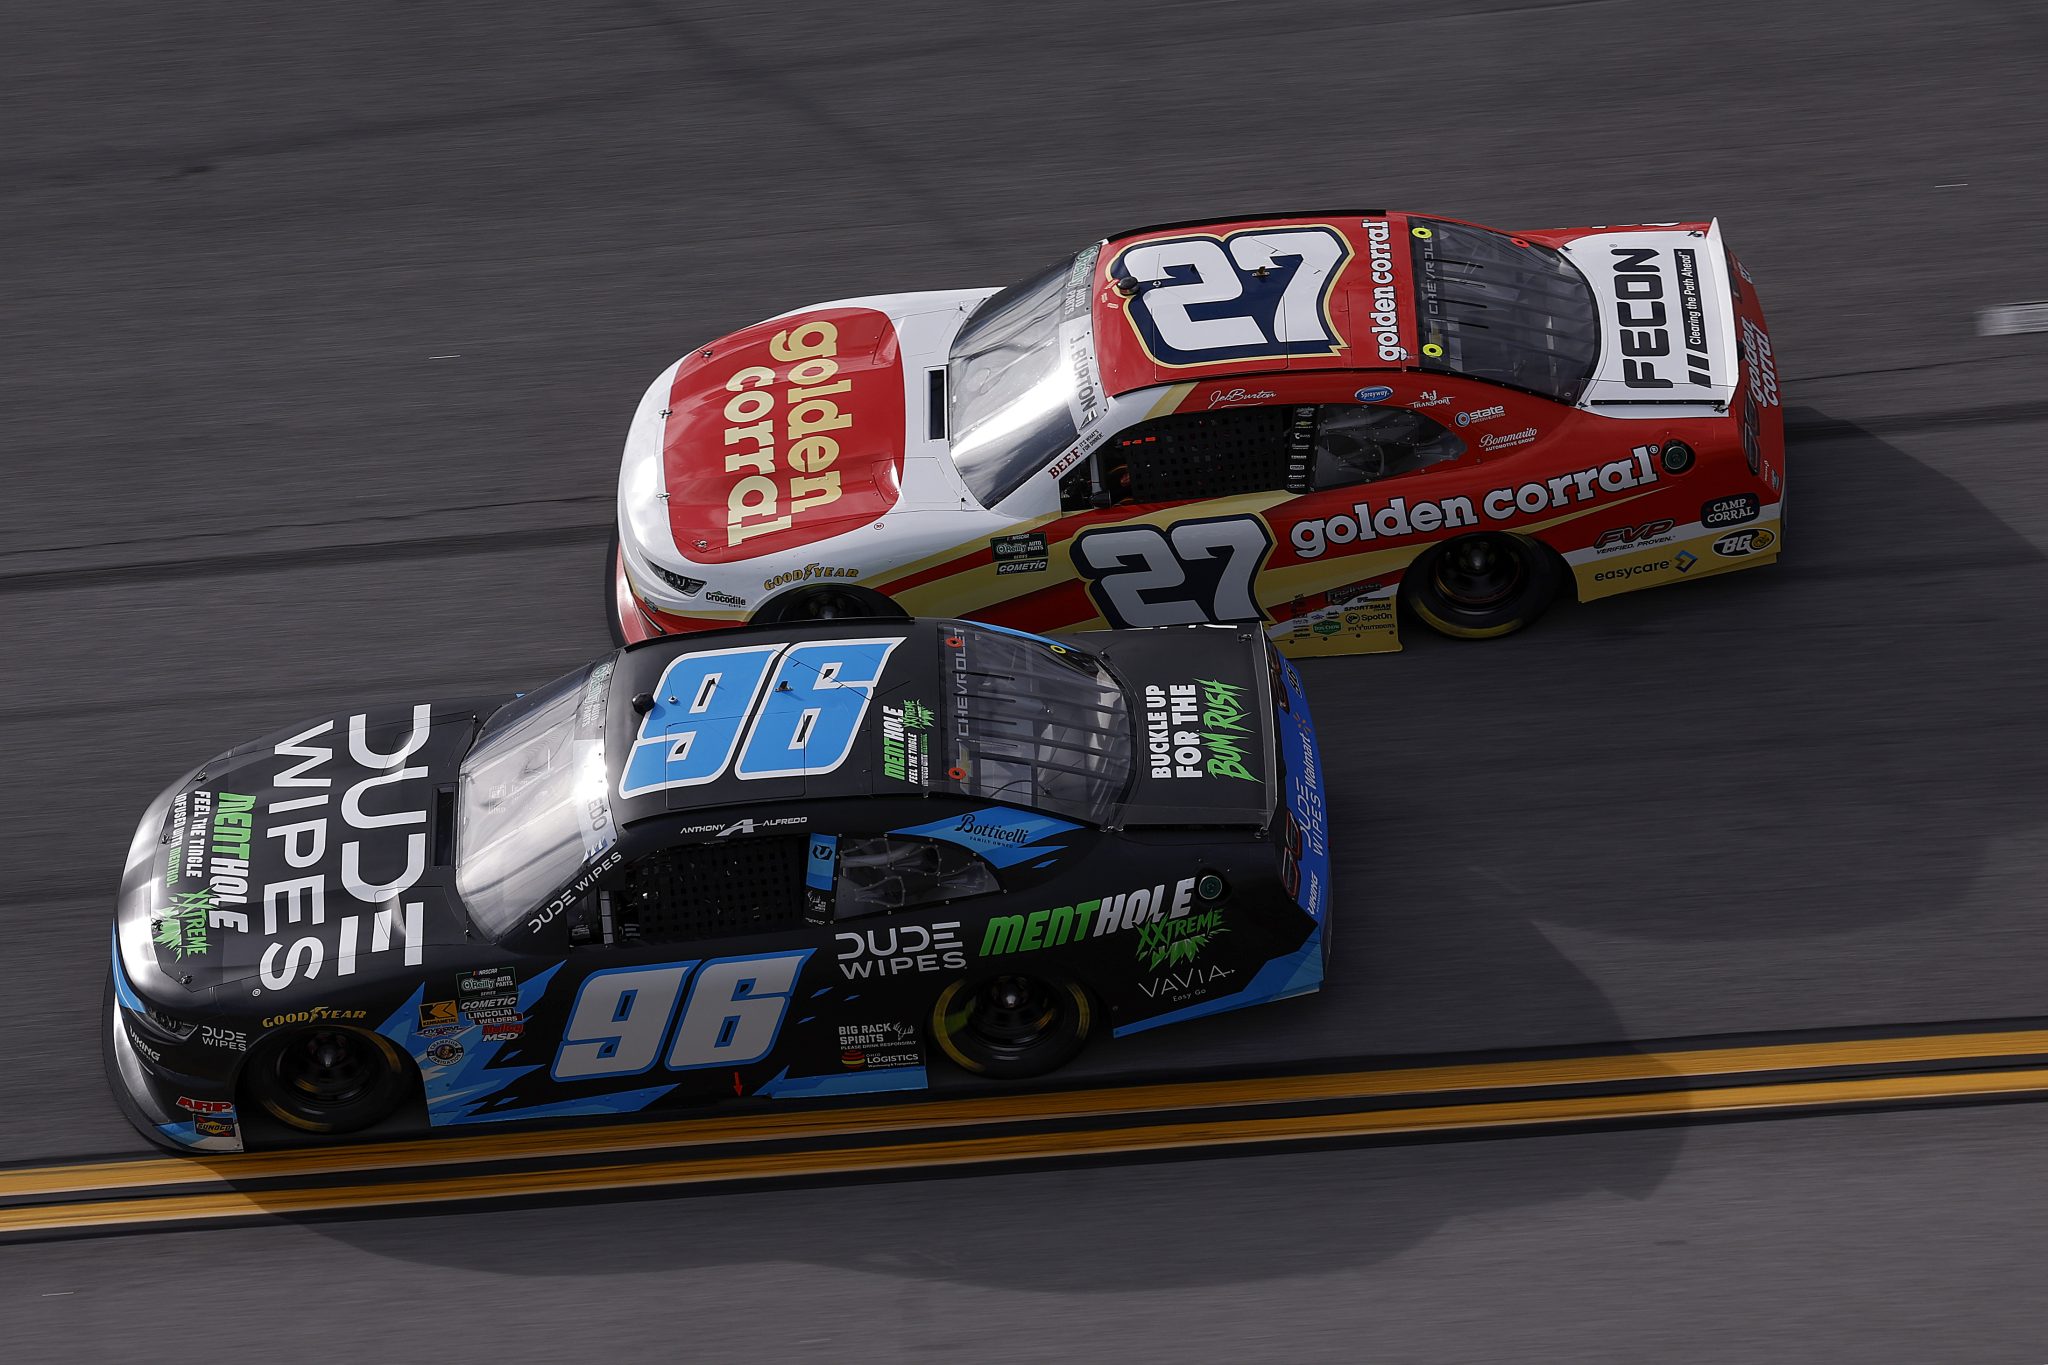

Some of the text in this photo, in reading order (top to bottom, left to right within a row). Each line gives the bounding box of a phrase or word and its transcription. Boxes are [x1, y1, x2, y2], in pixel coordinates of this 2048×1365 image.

[1115, 227, 1350, 364] 27
[1361, 221, 1407, 361] golden corral
[1680, 255, 1702, 345] Clearing the Path Ahead
[1611, 247, 1674, 389] FECON
[1740, 316, 1768, 408] golden
[1751, 322, 1779, 406] corral
[1072, 350, 1099, 414] BURTON
[770, 320, 853, 513] golden
[1470, 405, 1505, 420] state
[1479, 427, 1538, 448] Bommarito
[725, 366, 792, 547] corral
[1290, 445, 1661, 558] golden corral
[1707, 506, 1755, 524] CORRAL
[1713, 498, 1748, 512] CAMP
[1593, 518, 1677, 550] FVP
[1721, 534, 1752, 554] BG
[999, 560, 1047, 573] COMETIC
[1074, 514, 1273, 629] 27
[1594, 560, 1670, 582] easycare
[705, 591, 746, 606] Crocodile
[1361, 613, 1393, 621] SpotOn
[618, 637, 907, 800] 96
[1145, 685, 1171, 779] BUCKLE UP
[1169, 684, 1202, 778] FOR THE
[1198, 680, 1263, 782] BUM RUSH
[883, 705, 905, 781] MENTHOLE
[908, 755, 918, 768] THE
[908, 768, 919, 785] FEEL
[1299, 731, 1317, 790] Walmart
[186, 791, 212, 878] FEEL THE TINGLE
[338, 704, 431, 977] DUDE
[680, 824, 726, 834] ANTHONY
[762, 816, 808, 827] ALFREDO
[955, 814, 1029, 844] Botticelli
[1311, 794, 1324, 857] WIPES
[208, 792, 257, 933] MENTHOLE
[259, 720, 334, 990] WIPES
[528, 850, 624, 934] DUDE WIPES
[979, 877, 1197, 957] MENTHOLE
[835, 921, 964, 960] DUDE
[479, 968, 498, 976] NASCAR
[838, 952, 968, 981] WIPES
[1137, 965, 1232, 998] VAVIA
[461, 977, 496, 992] O'Reilly
[1173, 993, 1192, 1003] Easy
[461, 997, 517, 1010] COMETIC
[468, 1009, 513, 1019] LINCOLN
[549, 948, 818, 1084] 96
[202, 1025, 247, 1043] DUDE
[479, 1016, 518, 1025] WELDERS
[838, 1022, 892, 1036] BIG RACK
[129, 1025, 161, 1062] VIKING
[202, 1036, 247, 1052] WIPES
[482, 1033, 519, 1042] MSD
[840, 1033, 885, 1045] SPIRITS
[867, 1054, 919, 1064] LOGISTICS
[177, 1096, 233, 1113] ARP
[197, 1123, 233, 1132] SUNOCO
